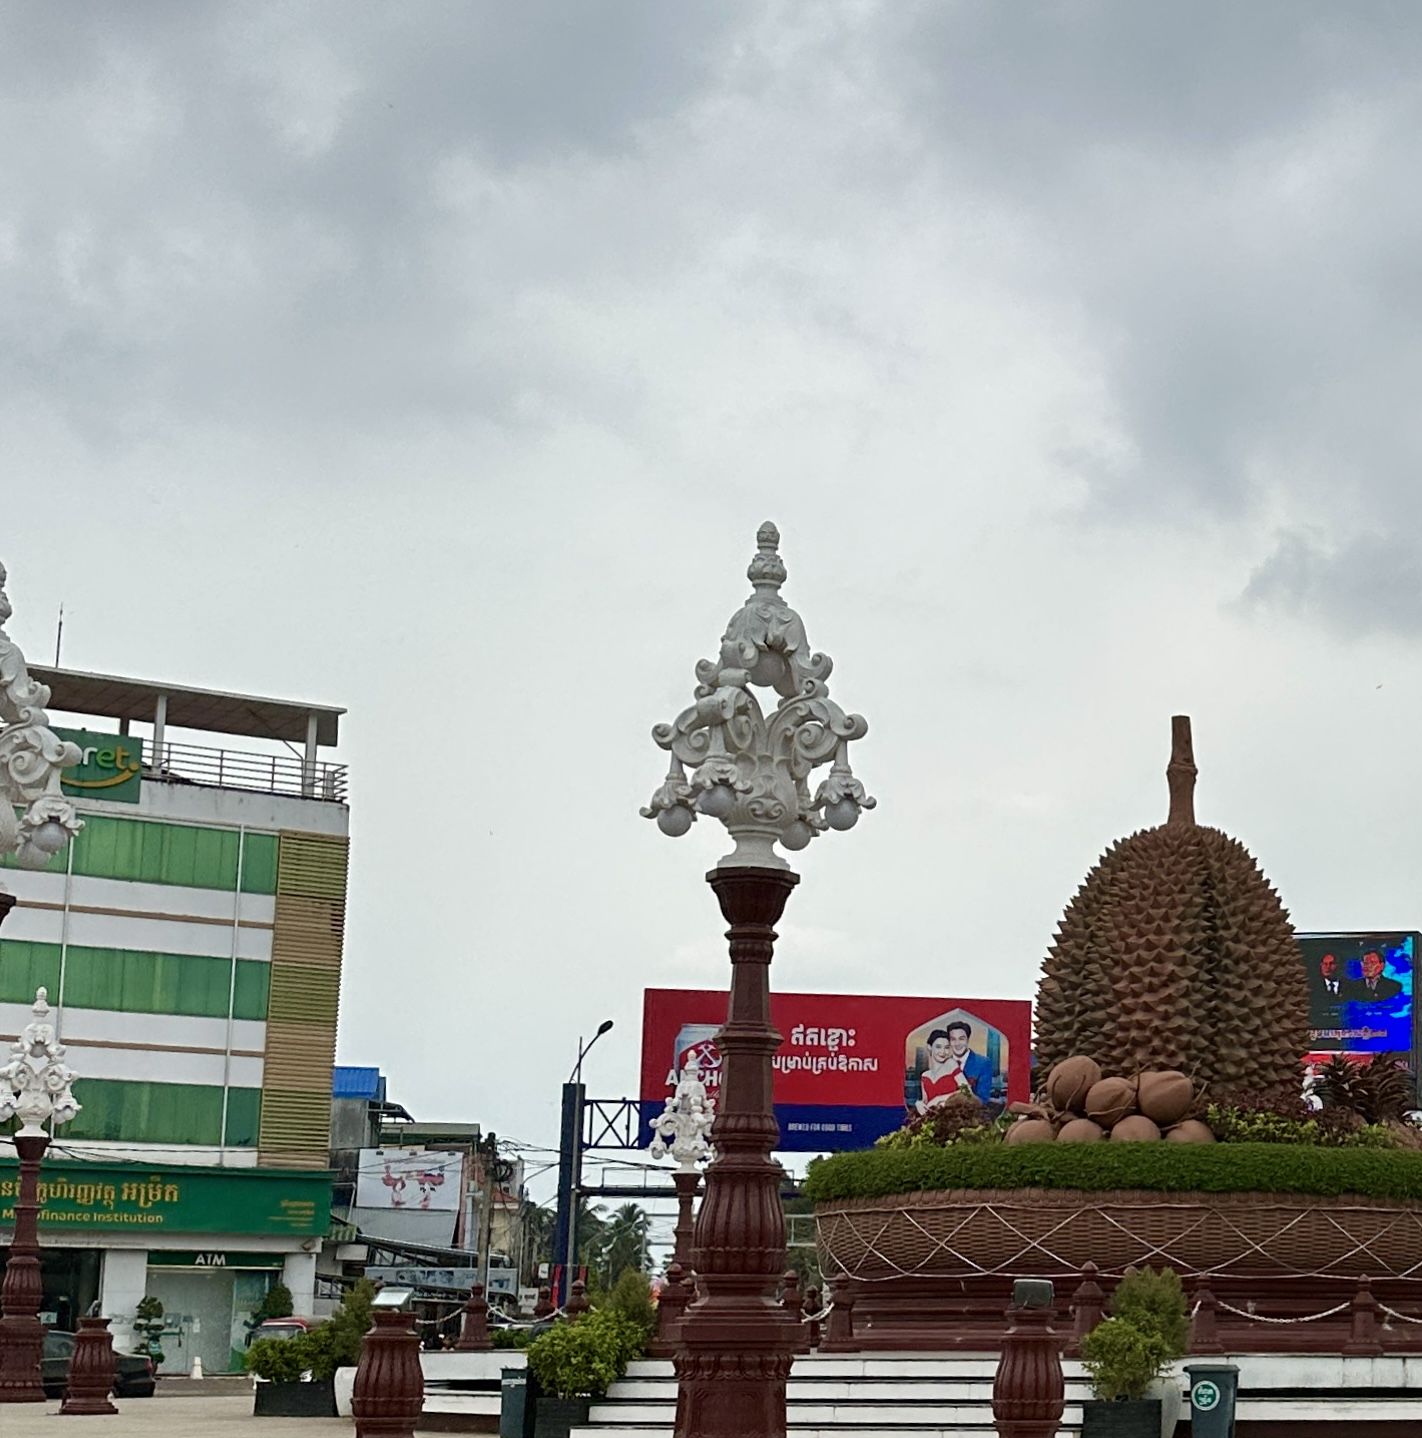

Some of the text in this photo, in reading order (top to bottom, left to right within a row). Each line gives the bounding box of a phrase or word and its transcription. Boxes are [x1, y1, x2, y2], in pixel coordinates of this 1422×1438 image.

[83, 746, 130, 769] ret
[2, 1208, 163, 1223] Mfinance Institution
[195, 1253, 226, 1266] ATM
